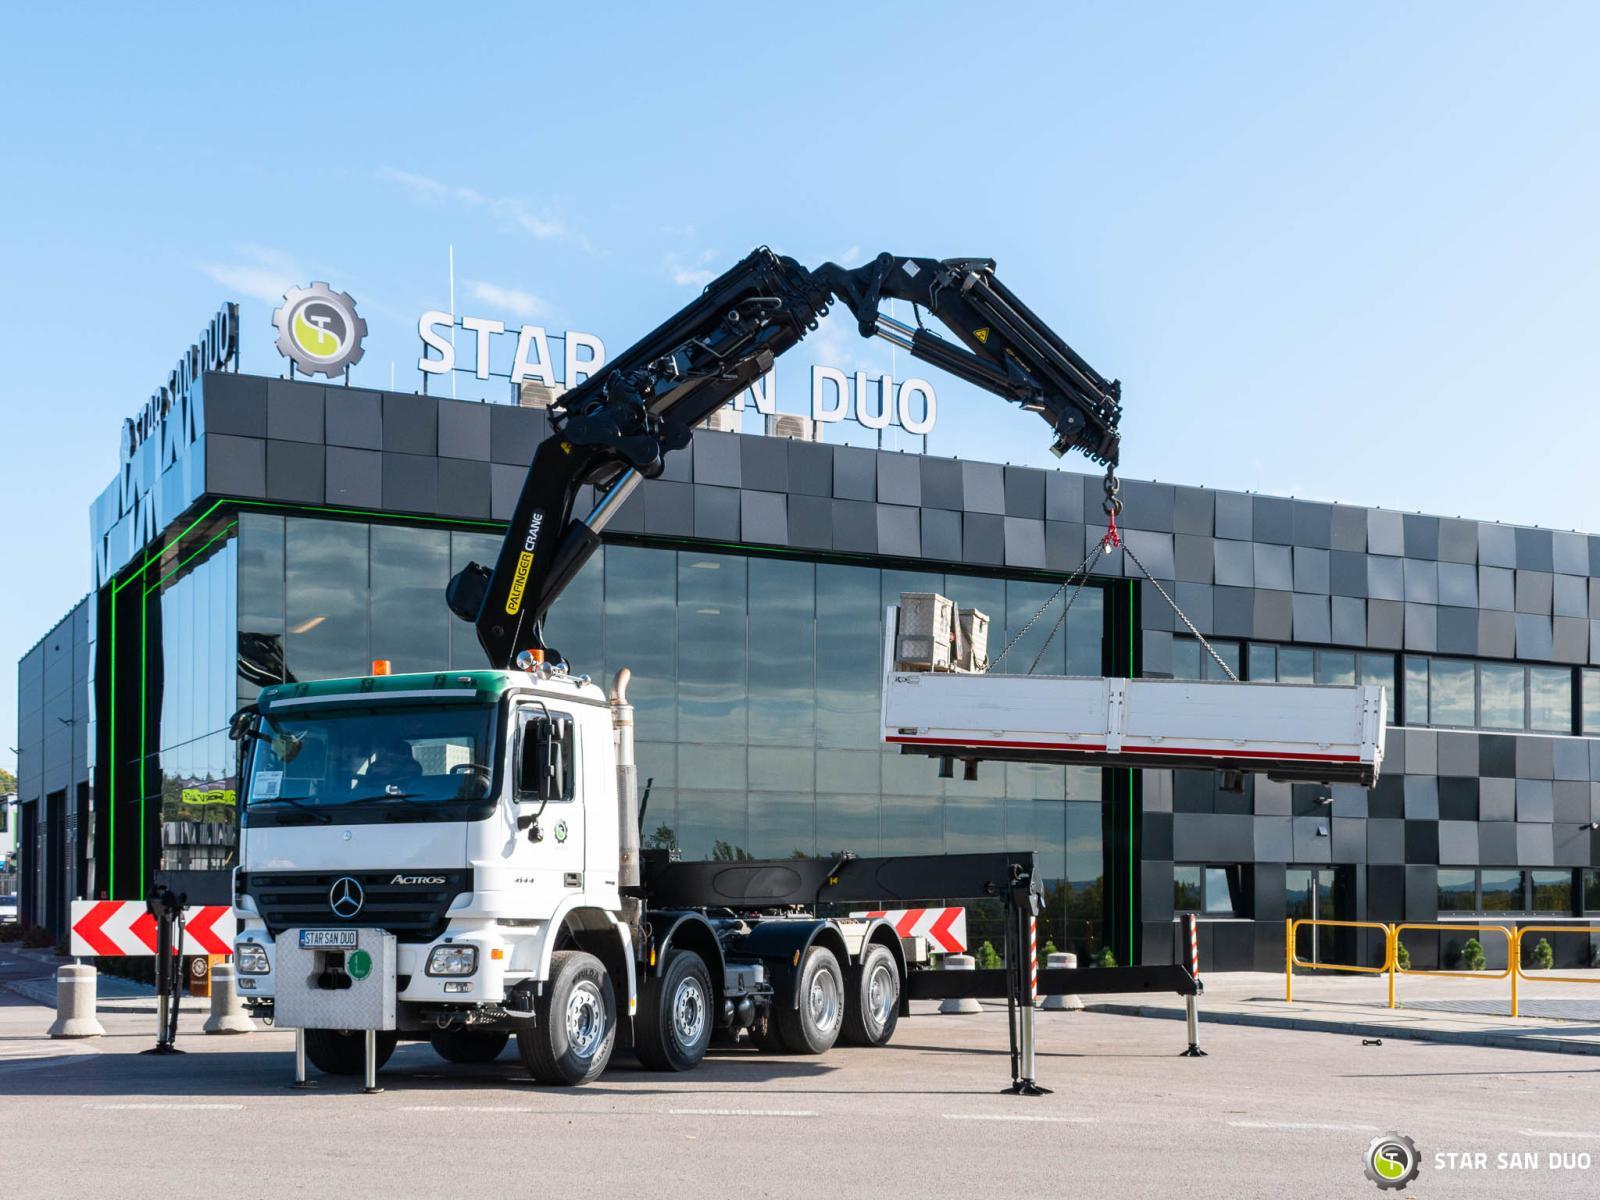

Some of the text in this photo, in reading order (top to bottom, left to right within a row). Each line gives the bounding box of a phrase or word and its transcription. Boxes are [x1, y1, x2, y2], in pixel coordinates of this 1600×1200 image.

[417, 310, 606, 391] STAR
[811, 364, 938, 436] DUO
[508, 513, 543, 611] PALFINGER CRANE
[305, 932, 355, 944] STAR SAN DUO
